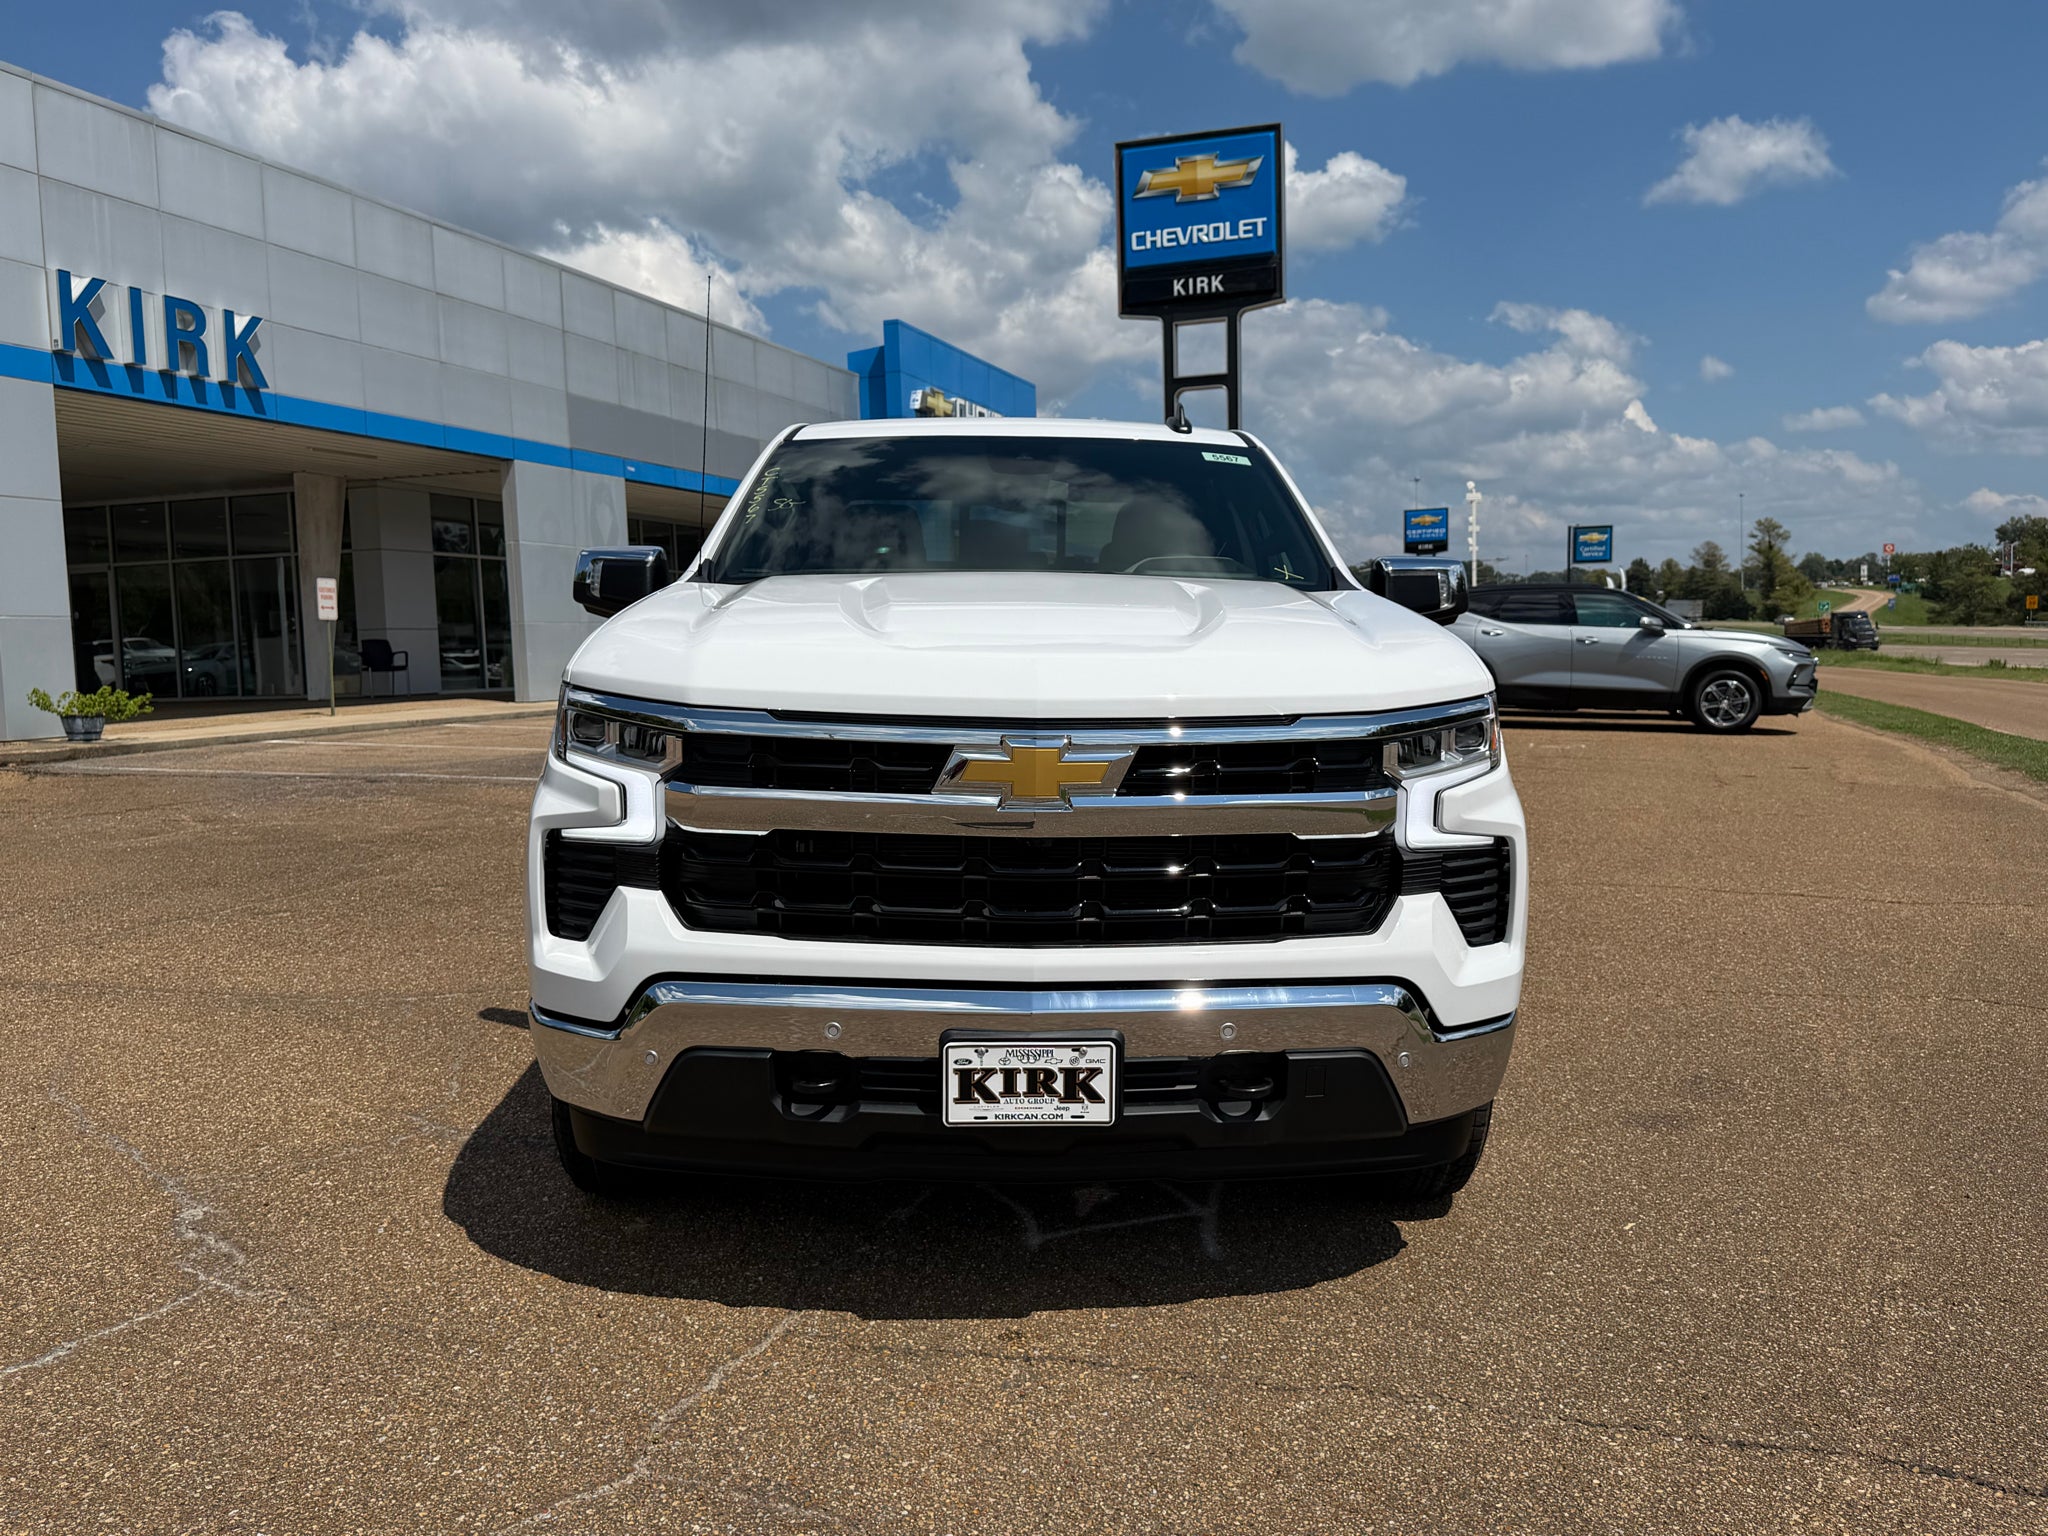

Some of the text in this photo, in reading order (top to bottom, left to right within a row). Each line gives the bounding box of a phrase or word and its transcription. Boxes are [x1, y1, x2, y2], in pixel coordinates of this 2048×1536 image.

[1131, 217, 1267, 251] CHEVROLET
[1173, 274, 1224, 296] KIRK
[57, 269, 269, 389] KIRK
[1005, 1049, 1054, 1064] MISSISSIPPI
[953, 1067, 1105, 1105] KIRK
